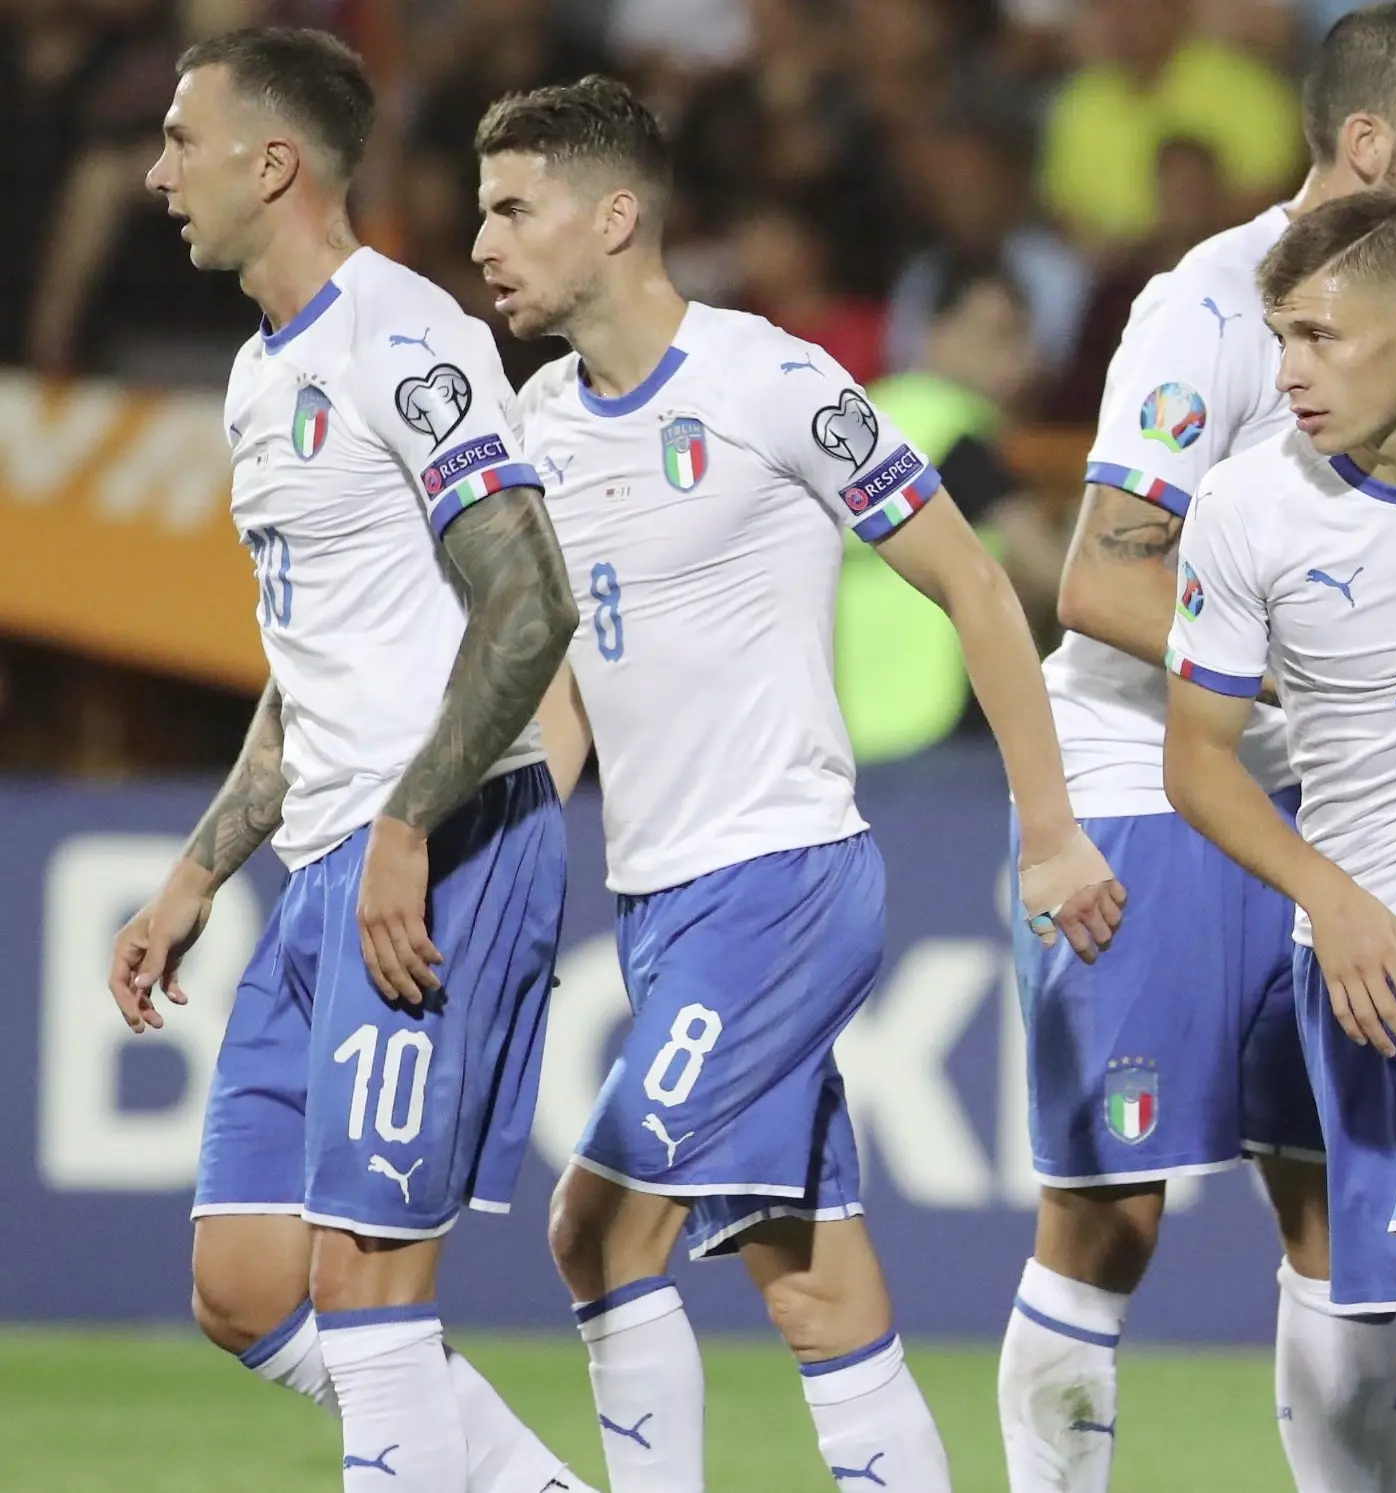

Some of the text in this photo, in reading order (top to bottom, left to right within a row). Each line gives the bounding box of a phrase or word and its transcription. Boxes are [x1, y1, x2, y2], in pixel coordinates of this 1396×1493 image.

[440, 440, 503, 479] RESPECT
[865, 450, 917, 498] RESPECT
[590, 561, 624, 662] 8
[333, 1023, 434, 1145] 10
[643, 1002, 723, 1108] 8
